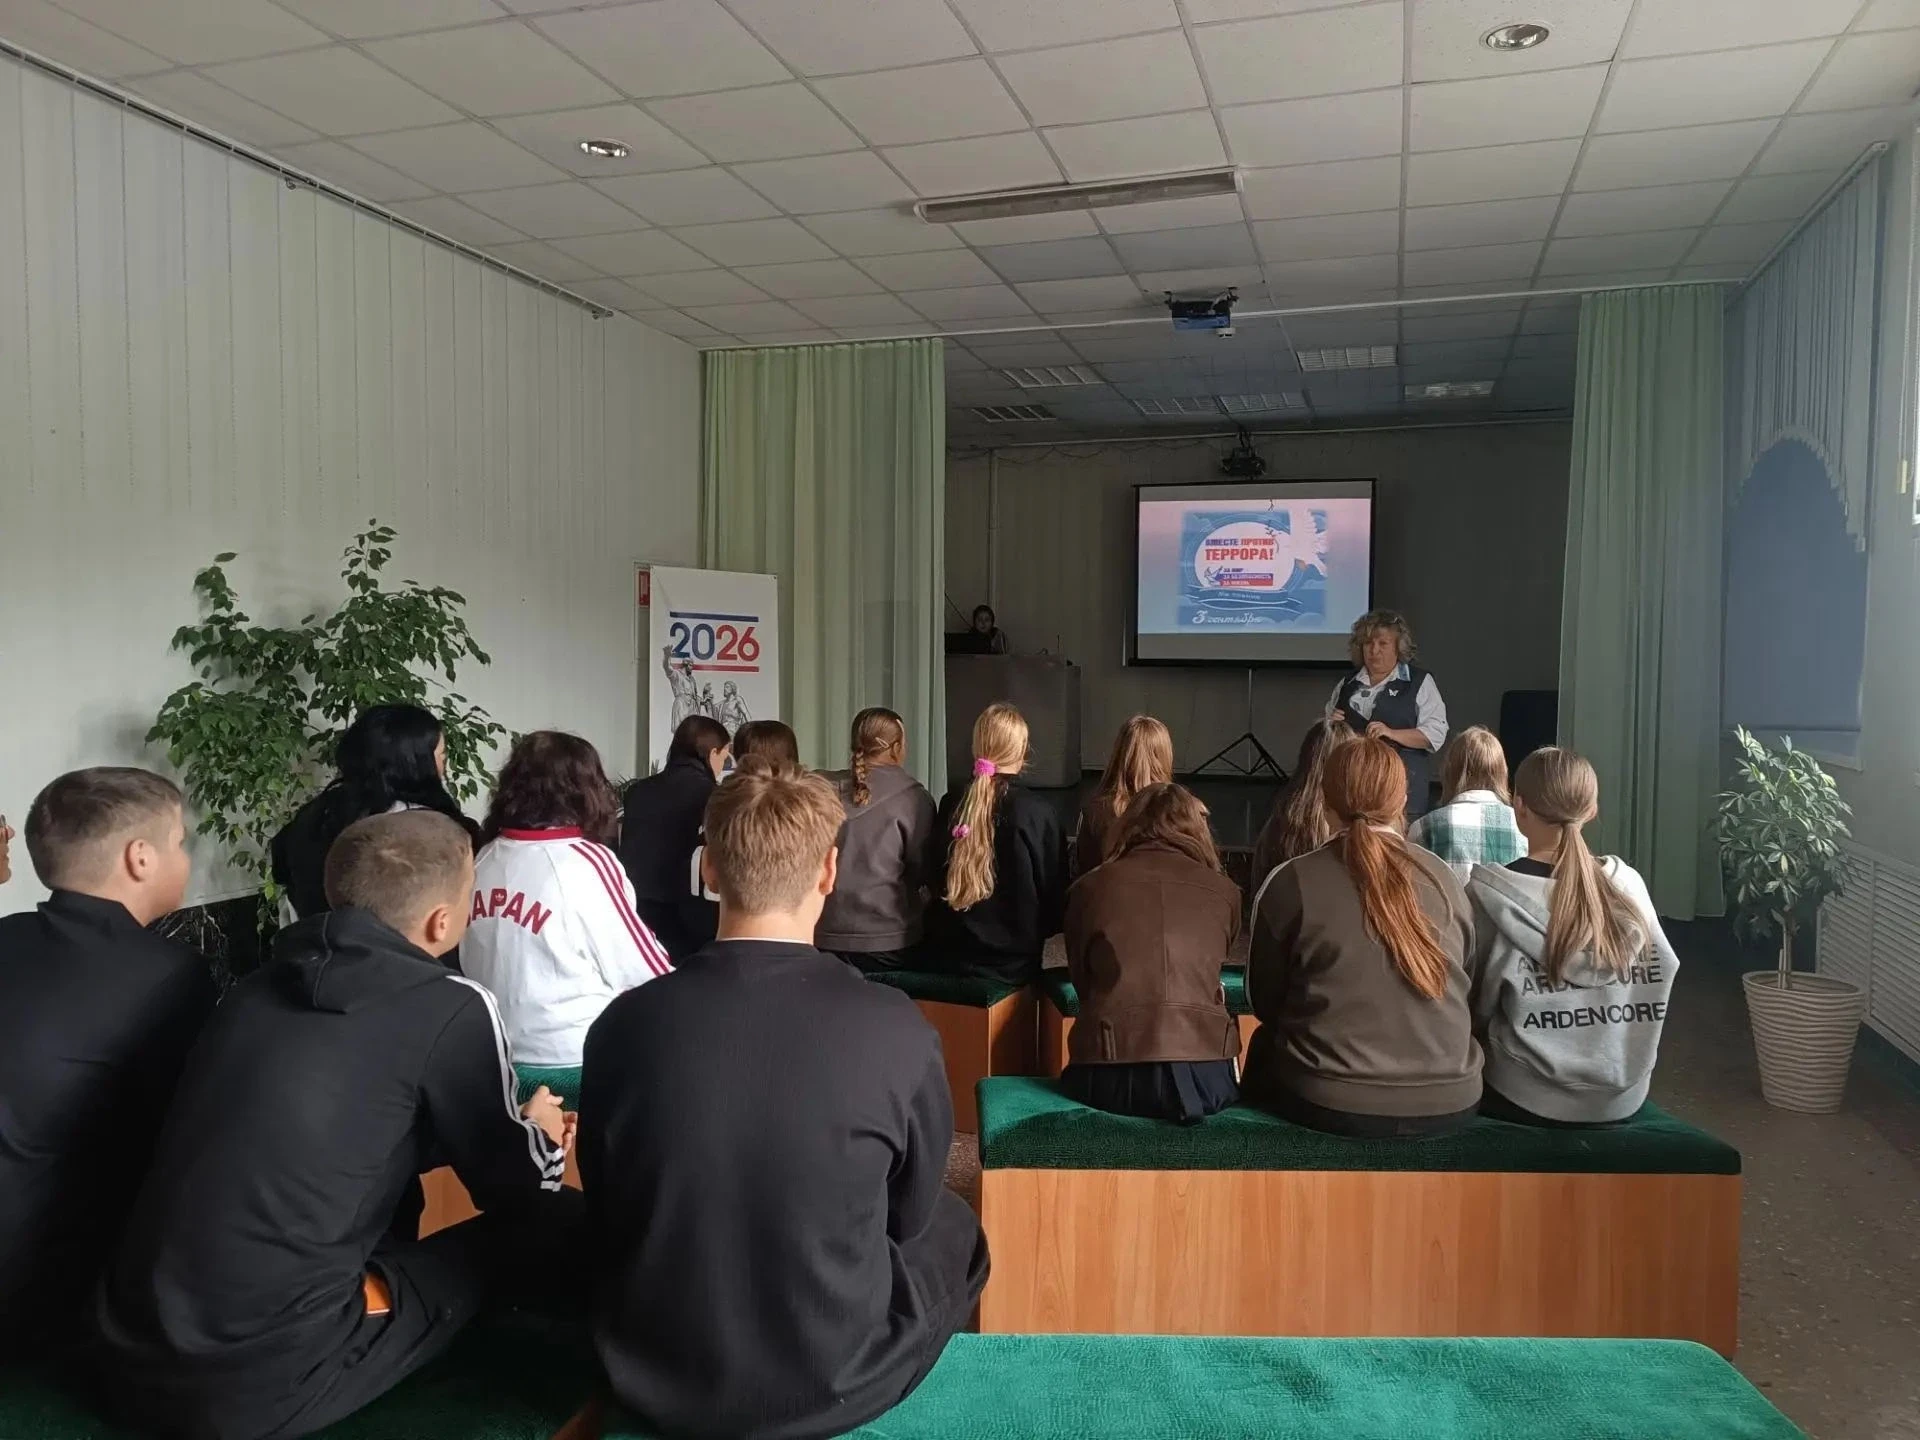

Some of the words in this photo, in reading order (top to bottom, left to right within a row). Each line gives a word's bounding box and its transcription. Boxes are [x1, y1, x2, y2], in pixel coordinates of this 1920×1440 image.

[1205, 548, 1274, 561] ТЕРРОРА!
[1192, 610, 1208, 624] 3
[669, 621, 760, 662] 2026
[466, 888, 552, 935] APAN
[1523, 1001, 1666, 1029] ARDENCORE
